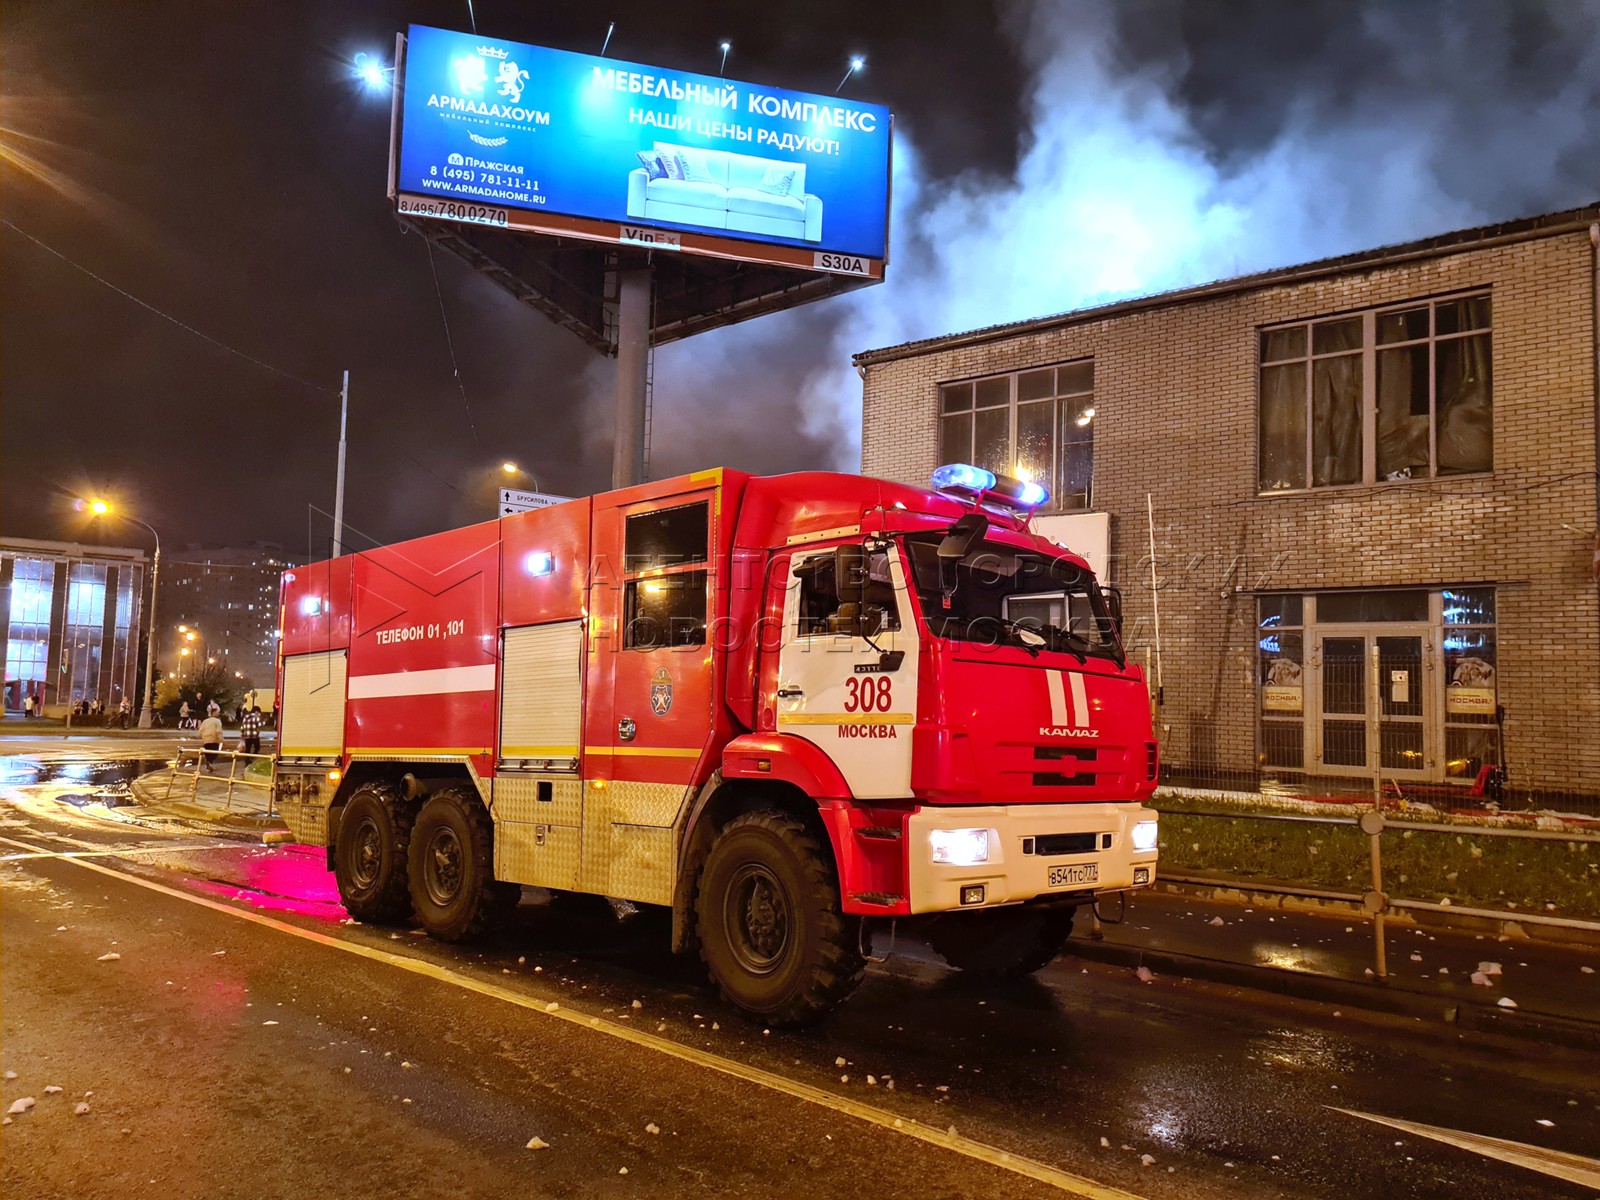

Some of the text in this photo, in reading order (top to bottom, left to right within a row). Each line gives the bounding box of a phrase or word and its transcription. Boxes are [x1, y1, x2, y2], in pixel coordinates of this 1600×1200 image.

[427, 94, 550, 125] АРМАДАХОУМ
[592, 66, 877, 133] МЕБЕЛЬНЫЙ КОМПЛЕКС
[629, 107, 840, 156] НАШИ ЦЕНЫ РАДУЮТ!
[430, 166, 539, 191] 8 (495) 781-11-11
[422, 178, 546, 205] WWW.ARMADAHOME.RU
[625, 228, 676, 245] VinEx
[821, 254, 864, 273] S30A
[376, 626, 424, 645] ТЕЛЕФОН
[844, 676, 892, 713] 308
[838, 724, 897, 739] МОСКВА
[1039, 727, 1099, 738] KAMAZ
